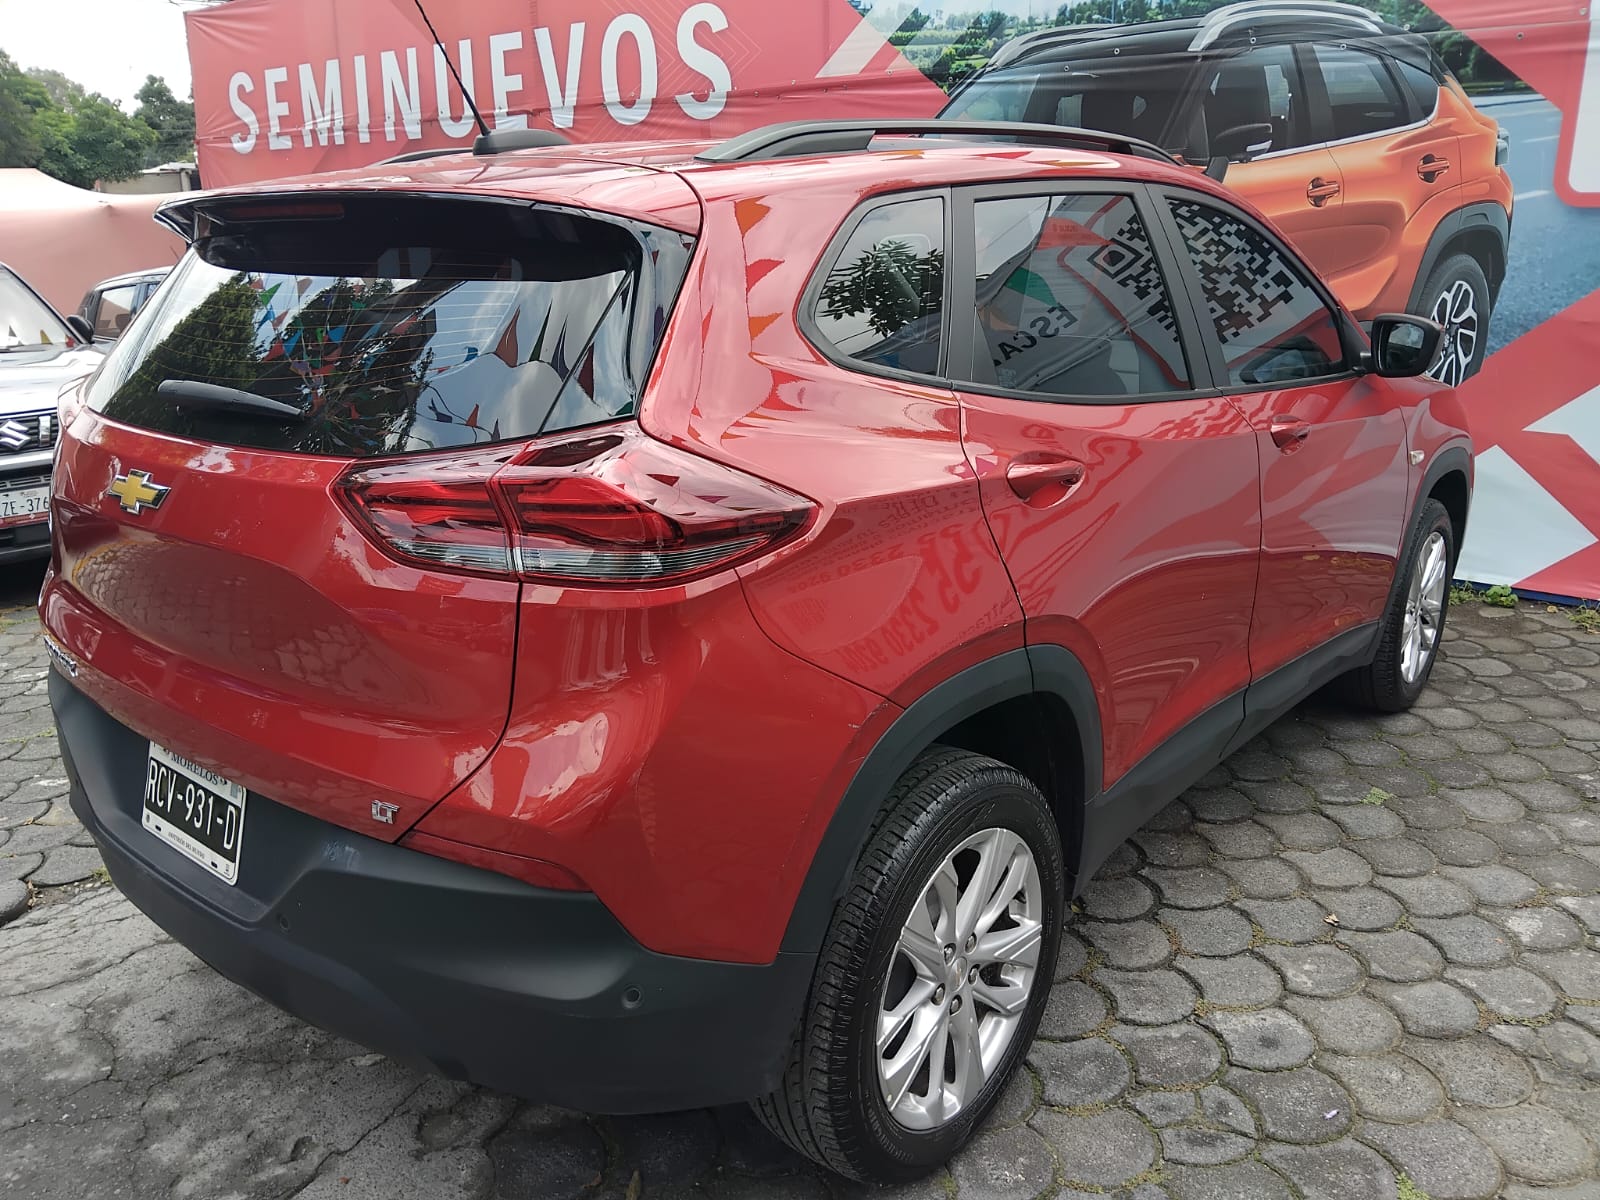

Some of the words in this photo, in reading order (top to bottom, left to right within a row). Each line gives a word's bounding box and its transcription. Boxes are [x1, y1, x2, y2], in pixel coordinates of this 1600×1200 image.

[228, 3, 732, 154] SEMINUEVOS
[171, 752, 217, 785] MORELOS
[147, 760, 236, 849] RCV-931-D
[372, 799, 400, 824] LT
